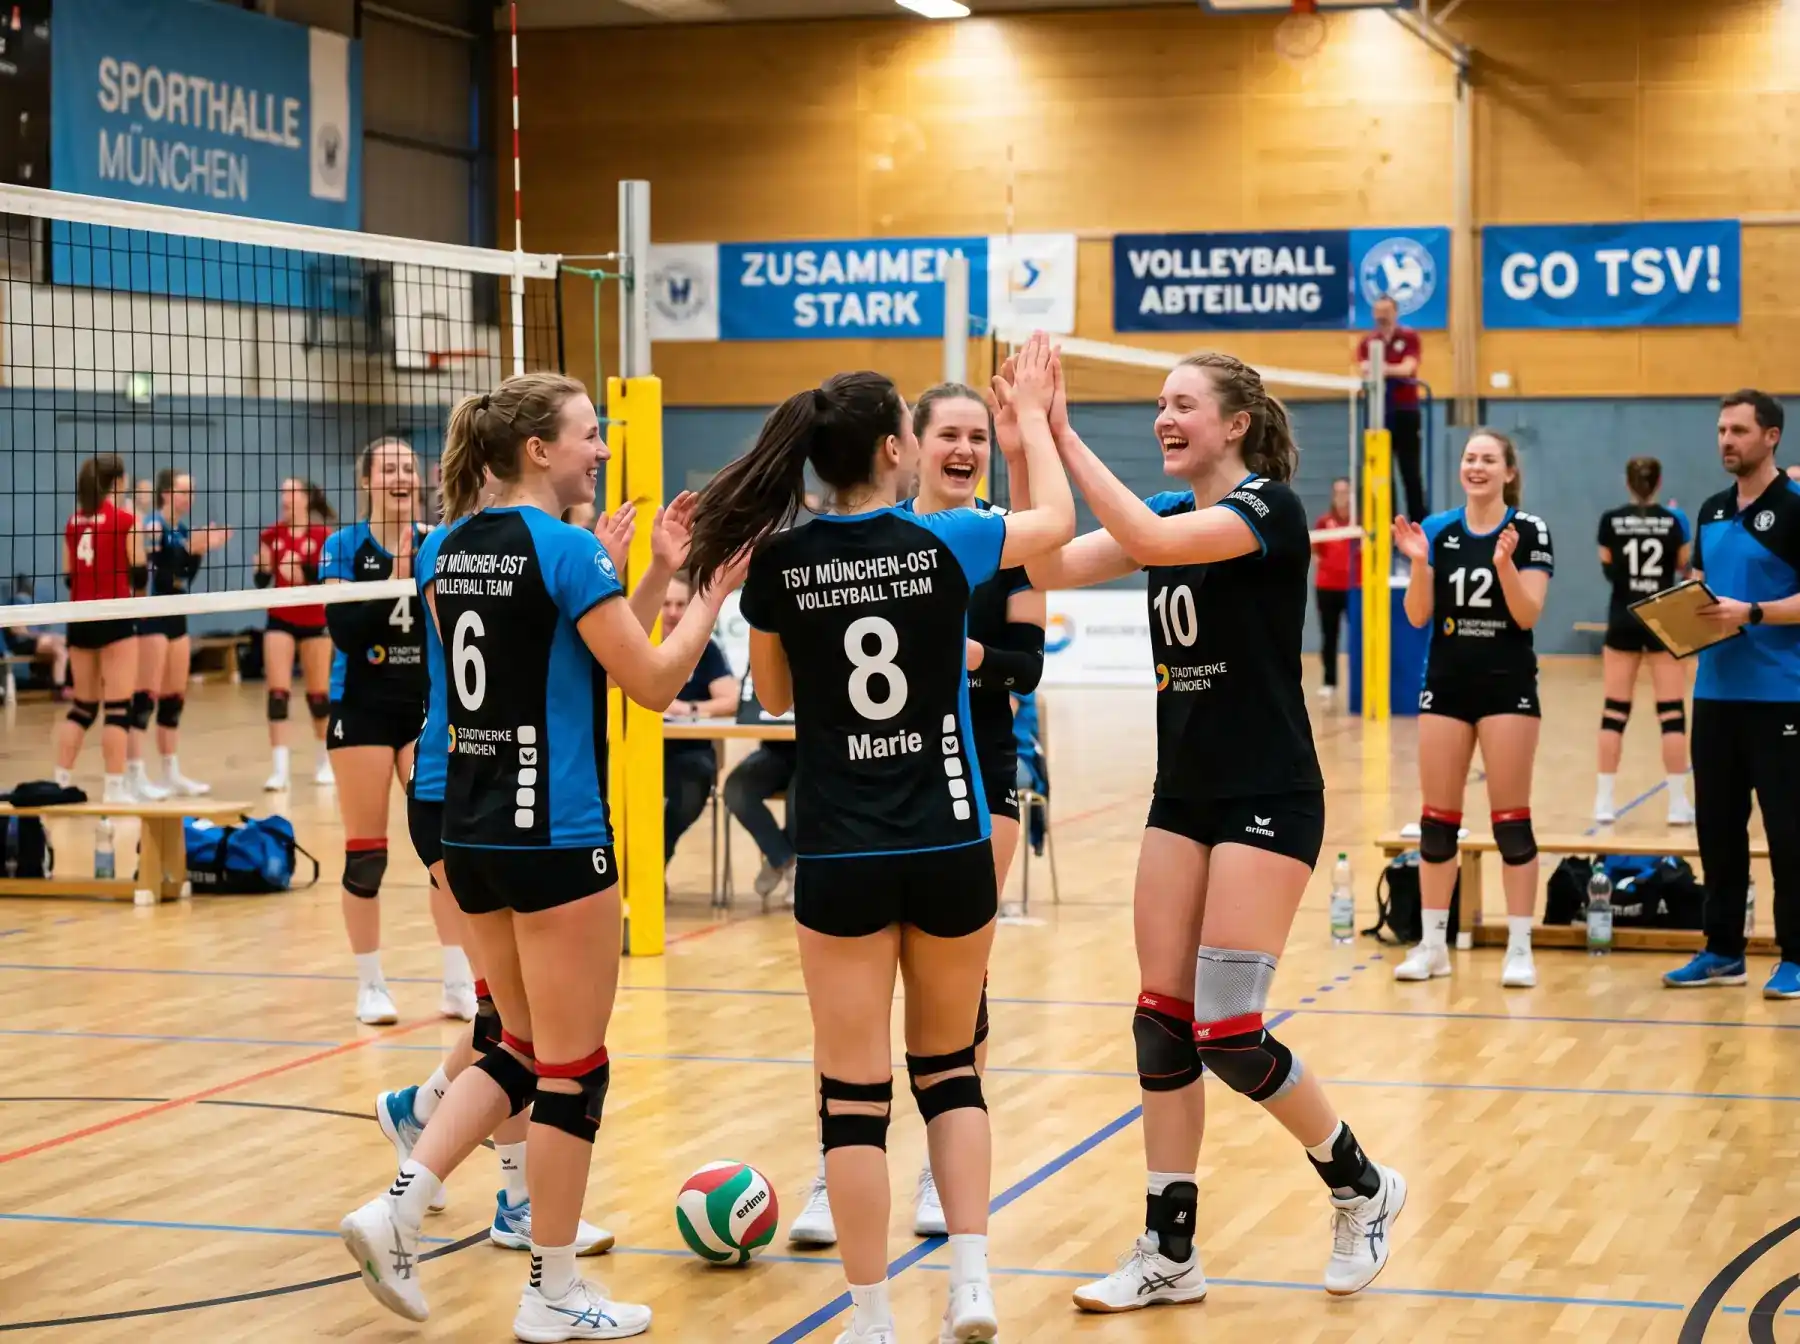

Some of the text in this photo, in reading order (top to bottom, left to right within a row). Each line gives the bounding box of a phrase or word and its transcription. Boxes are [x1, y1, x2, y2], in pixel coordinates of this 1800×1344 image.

[97, 56, 301, 148] SPORTHALLE
[99, 122, 247, 202] MÜNCHEN
[1127, 245, 1336, 279] VOLLEYBALL
[1501, 245, 1721, 300] GO TSV!
[793, 291, 921, 327] STARK
[1139, 282, 1322, 314] ABTEILUNG
[77, 527, 95, 567] 4
[447, 551, 528, 575] MÜNCHEN-OST
[1622, 538, 1664, 577] 12
[782, 549, 938, 589] TSV MÜNCHEN-OST
[486, 580, 513, 597] TEAM
[796, 576, 933, 611] VOLLEYBALL TEAM
[1448, 567, 1493, 608] 12
[388, 594, 414, 633] 4
[1153, 584, 1198, 647] 10
[452, 610, 487, 712] 6
[844, 616, 908, 721] 8
[1170, 662, 1228, 678] STADTWERKE
[1173, 678, 1212, 692] MÜNCHEN
[1418, 690, 1434, 710] 12
[334, 719, 344, 740] 4
[458, 727, 512, 742] STADTWERKE
[847, 729, 923, 761] Marie
[458, 741, 497, 756] MÜNCHEN
[1245, 825, 1275, 838] erima
[592, 847, 607, 875] 6
[736, 1189, 767, 1219] erima
